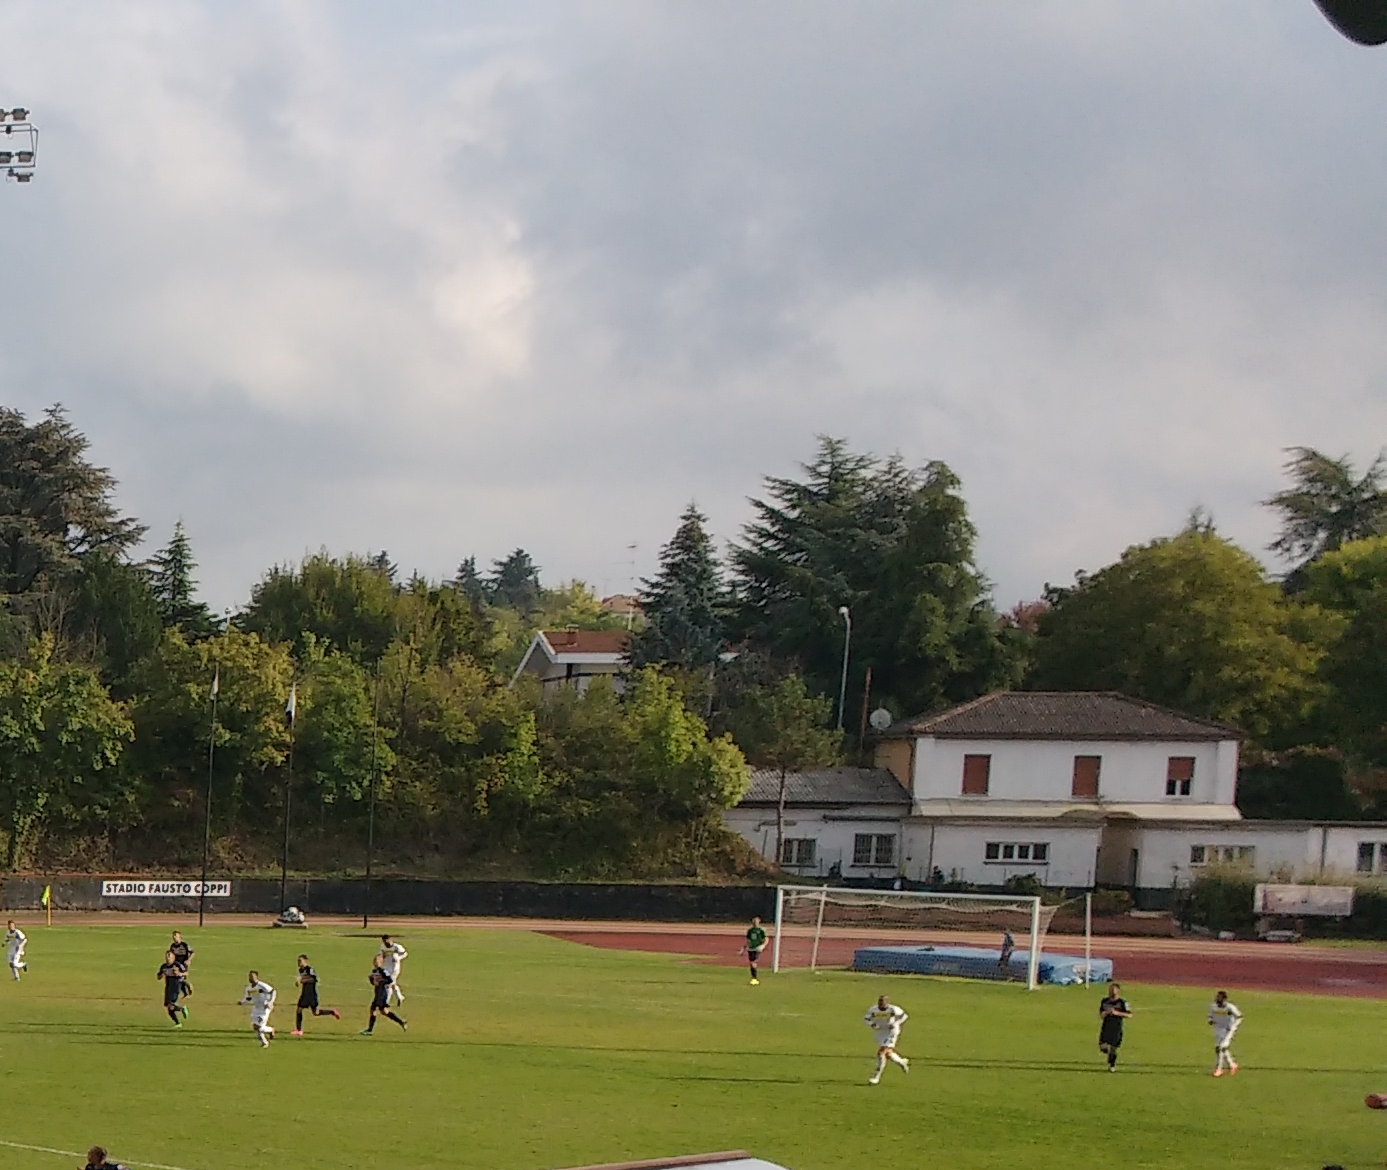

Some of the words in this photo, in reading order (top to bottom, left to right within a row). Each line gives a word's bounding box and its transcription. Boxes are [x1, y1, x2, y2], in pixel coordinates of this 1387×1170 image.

[105, 883, 146, 893] STADIO
[148, 883, 192, 893] FAUSTO
[194, 883, 227, 893] COPPI
